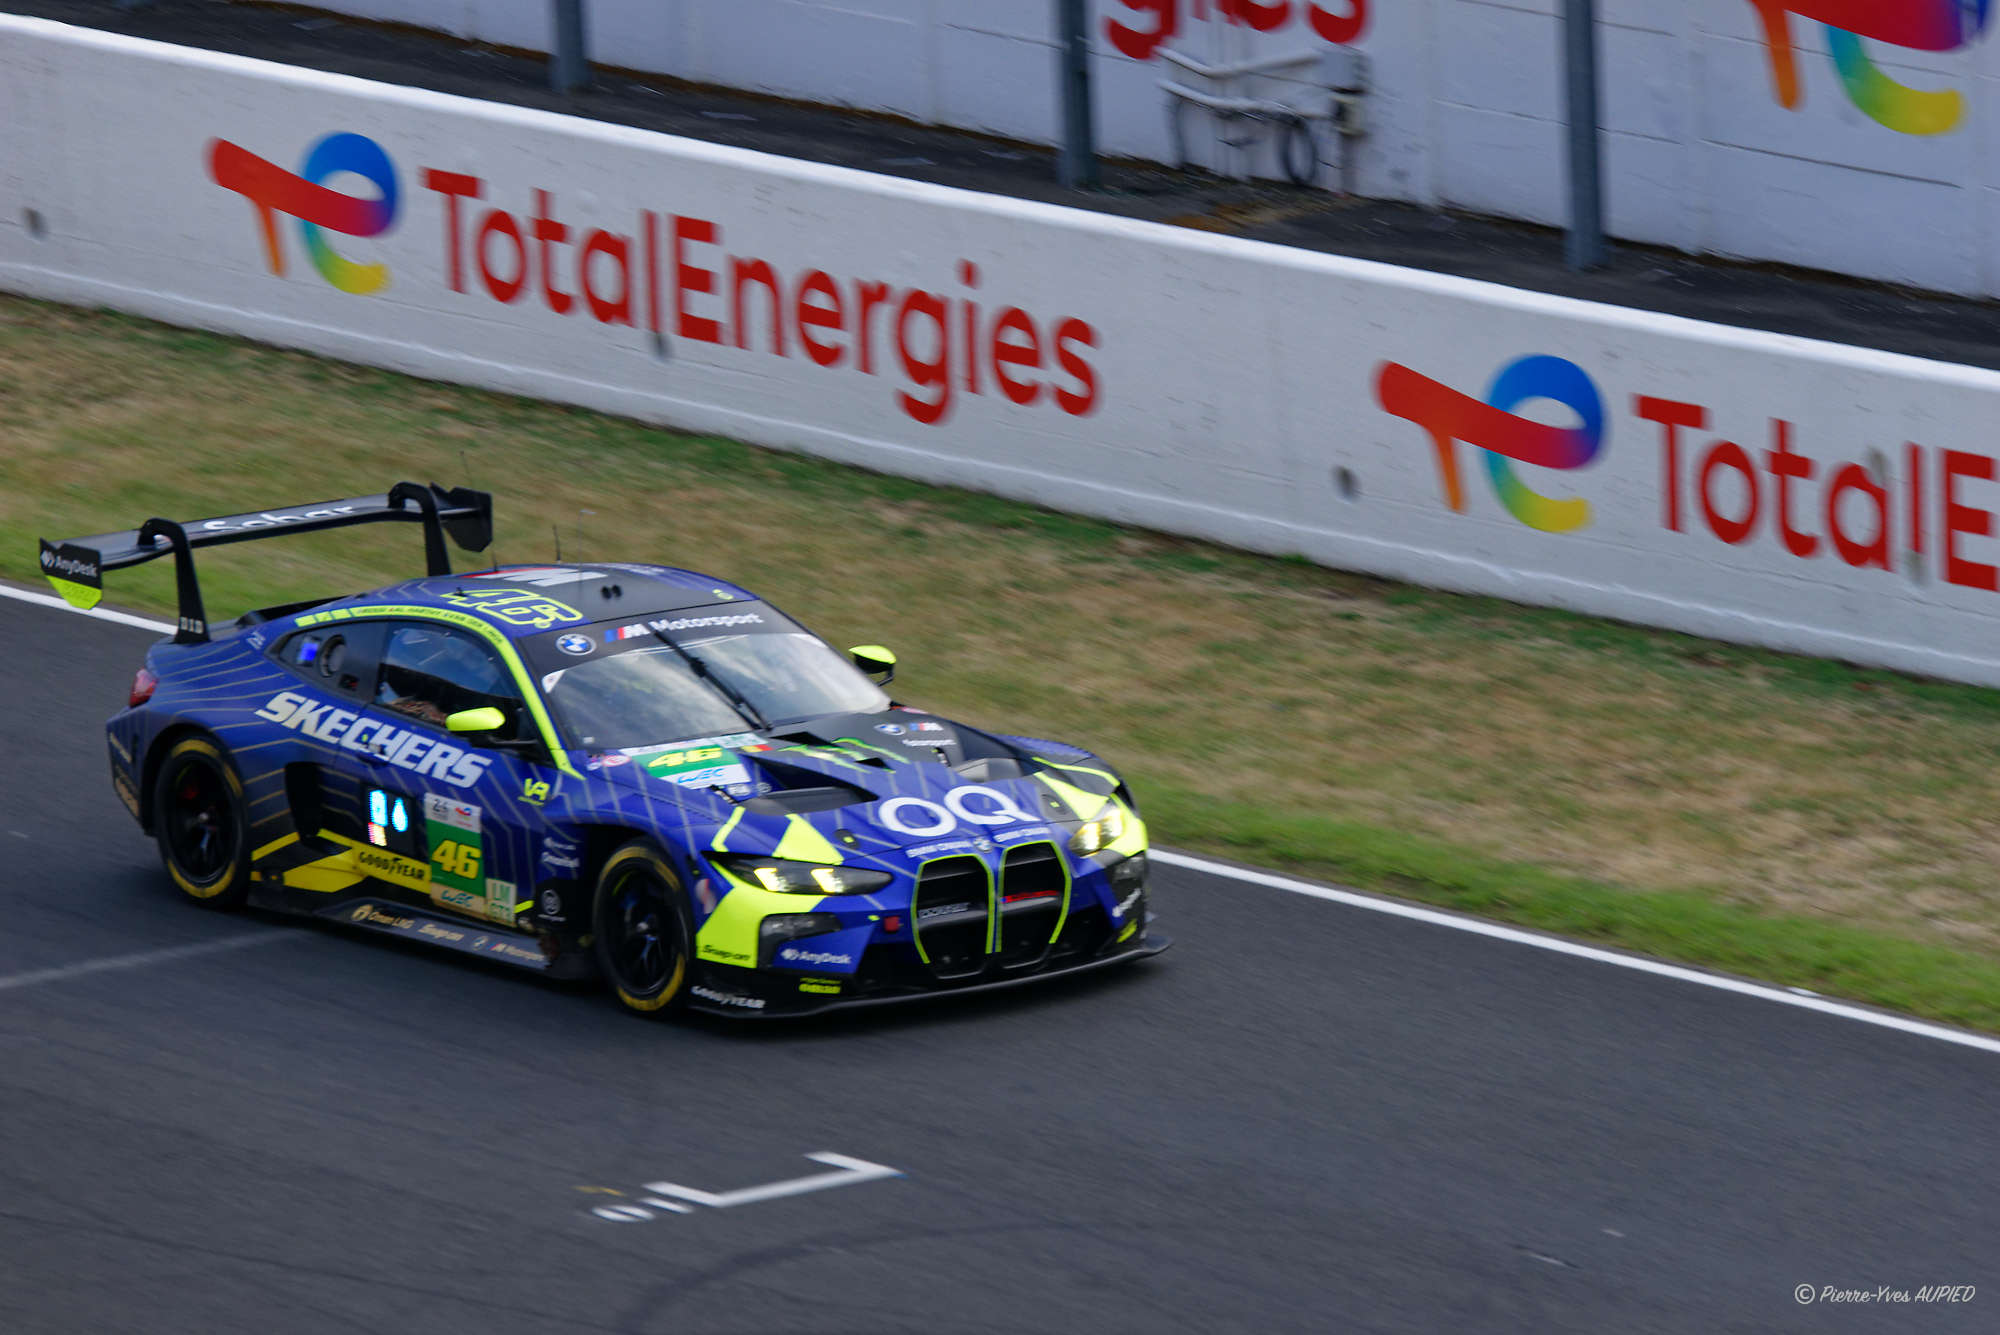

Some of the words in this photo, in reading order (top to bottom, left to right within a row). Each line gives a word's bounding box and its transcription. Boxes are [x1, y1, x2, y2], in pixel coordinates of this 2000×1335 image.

[419, 165, 1099, 427] TotalEnergies
[56, 555, 98, 578] AnyDesk
[647, 612, 765, 632] Motorsport
[254, 691, 494, 789] SKECHERS
[648, 747, 722, 768] 46
[879, 785, 1042, 837] OQ
[432, 839, 482, 880] 46
